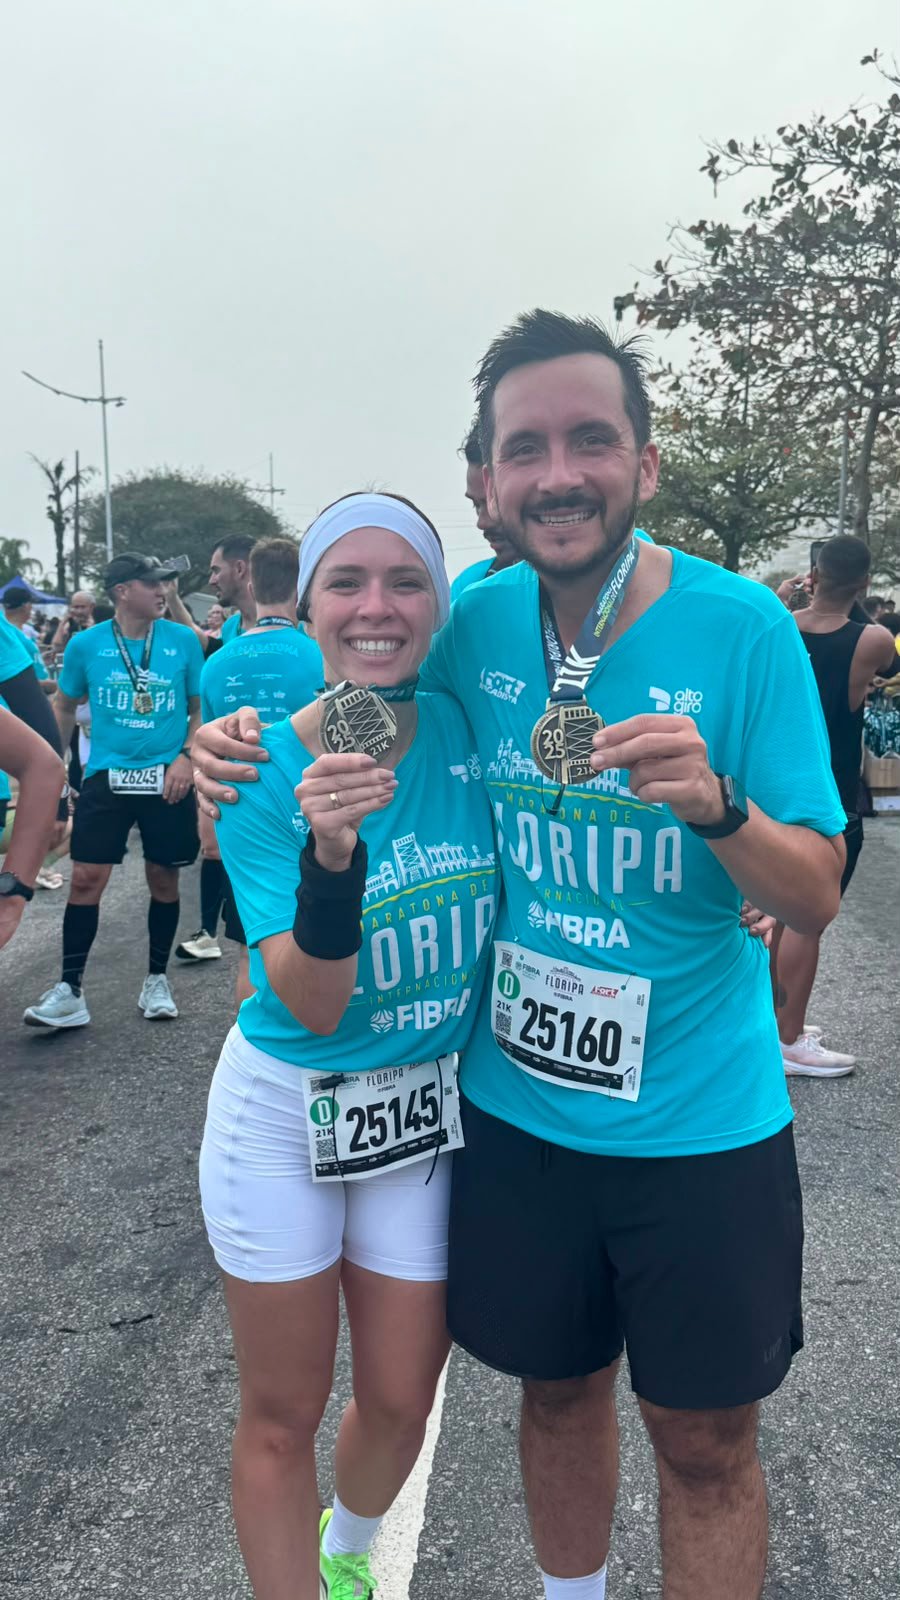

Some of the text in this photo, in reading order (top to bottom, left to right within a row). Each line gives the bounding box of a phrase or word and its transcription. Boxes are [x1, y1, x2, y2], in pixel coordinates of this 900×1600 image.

[611, 550, 635, 595] FLORIPA
[553, 644, 602, 693] 21K
[97, 686, 176, 713] FLOPA
[674, 687, 703, 703] alto
[673, 700, 702, 716] giro
[122, 718, 155, 729] FIBRA
[327, 719, 350, 742] 20
[542, 729, 565, 745] 20
[370, 740, 390, 757] 21K
[544, 744, 566, 760] 25
[121, 768, 157, 785] 26245
[506, 791, 631, 824] MARAONA DE
[470, 879, 488, 896] DE
[522, 963, 541, 977] FIBRA
[504, 972, 514, 996] D
[545, 974, 584, 996] FLORIPA
[557, 993, 573, 1002] FIBRA
[496, 1000, 512, 1013] 21K
[519, 997, 622, 1067] 25160
[343, 1075, 360, 1084] BRA
[366, 1067, 404, 1087] FLORIPA
[382, 1084, 396, 1093] FIBRA
[317, 1099, 331, 1124] D
[345, 1081, 440, 1153] 25145
[315, 1127, 335, 1138] 21K
